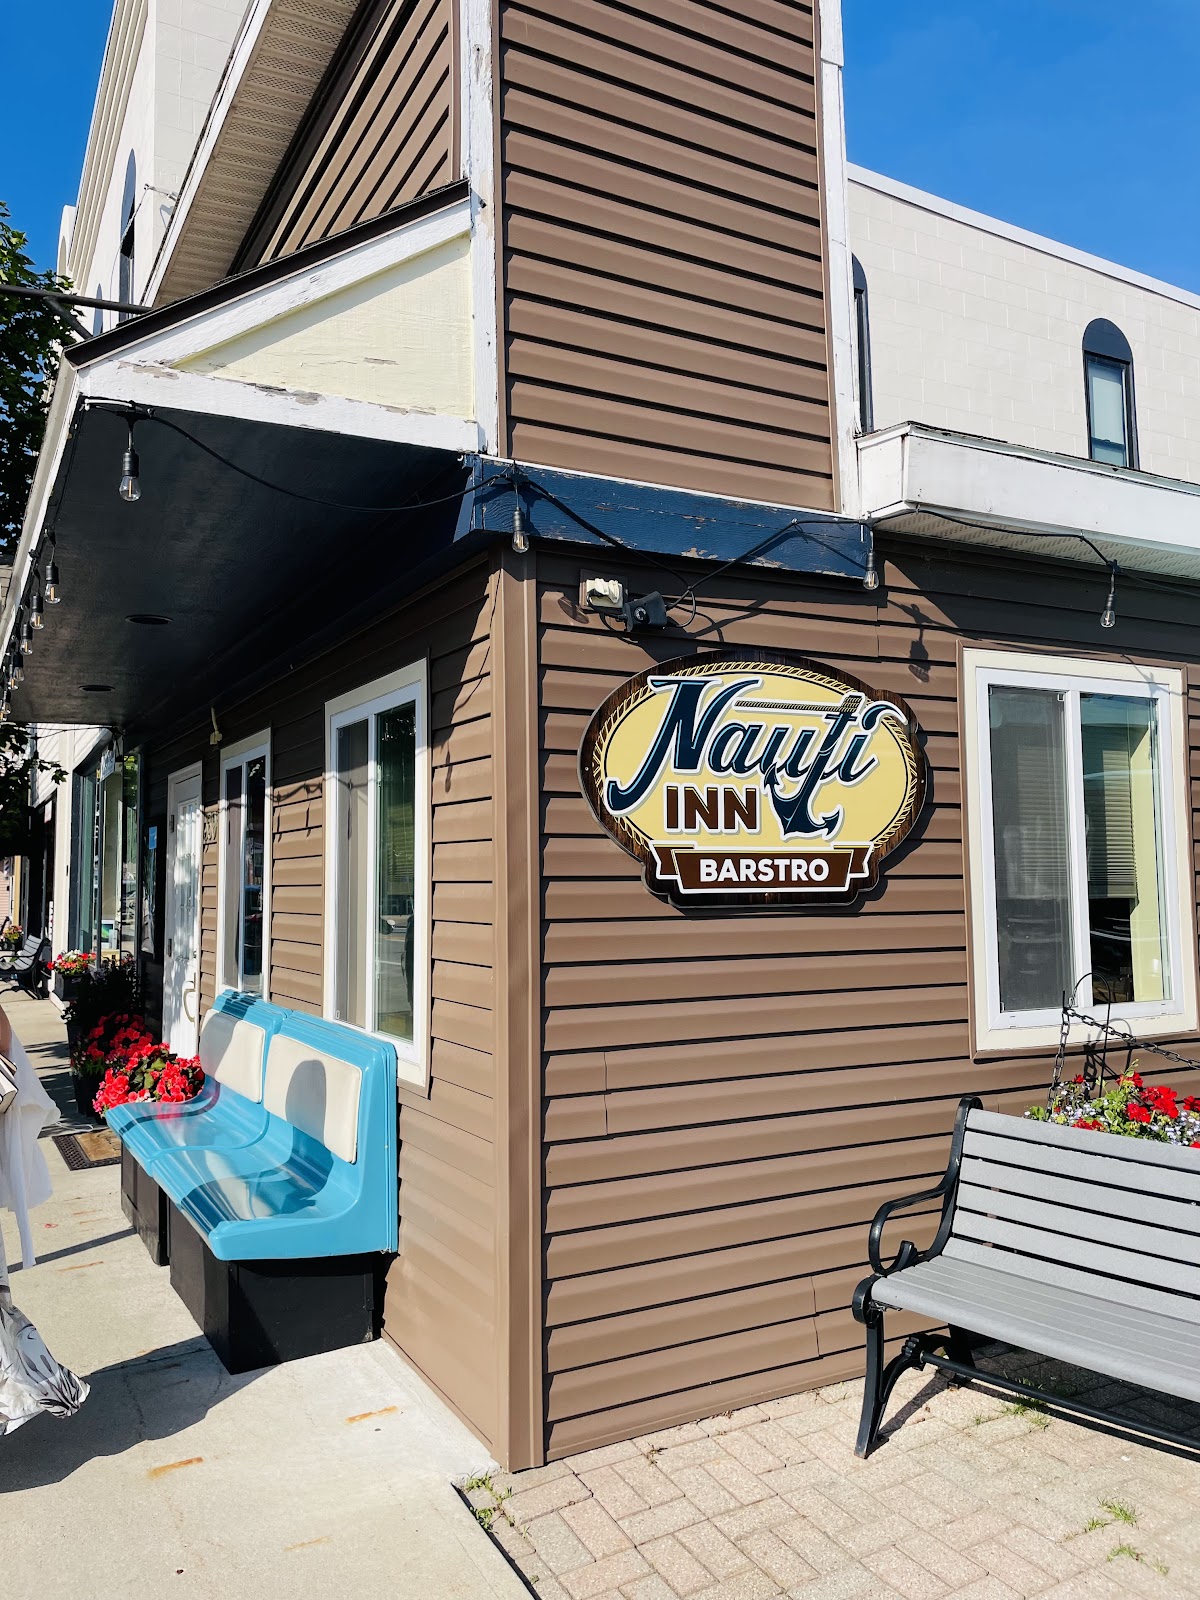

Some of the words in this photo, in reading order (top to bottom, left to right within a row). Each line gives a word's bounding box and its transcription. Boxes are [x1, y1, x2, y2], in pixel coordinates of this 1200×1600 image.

[606, 678, 905, 836] Nauti
[665, 785, 758, 831] INN
[699, 858, 829, 883] BARSTRO
